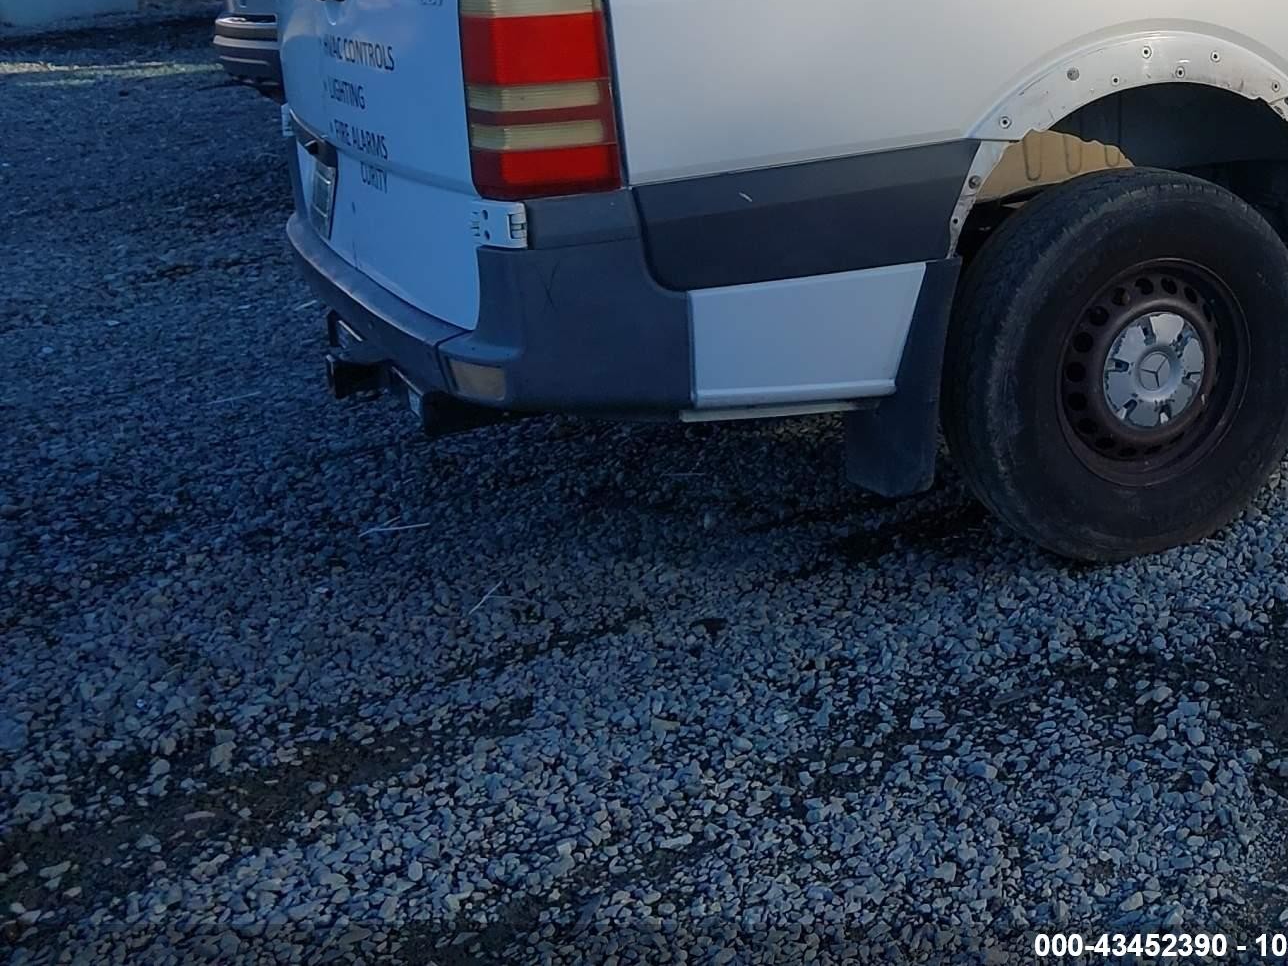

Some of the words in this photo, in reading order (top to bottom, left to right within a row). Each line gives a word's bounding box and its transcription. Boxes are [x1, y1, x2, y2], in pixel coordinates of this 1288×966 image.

[343, 38, 395, 72] CONTROLS
[328, 77, 366, 110] LIGHTING
[351, 125, 388, 160] ALARMS
